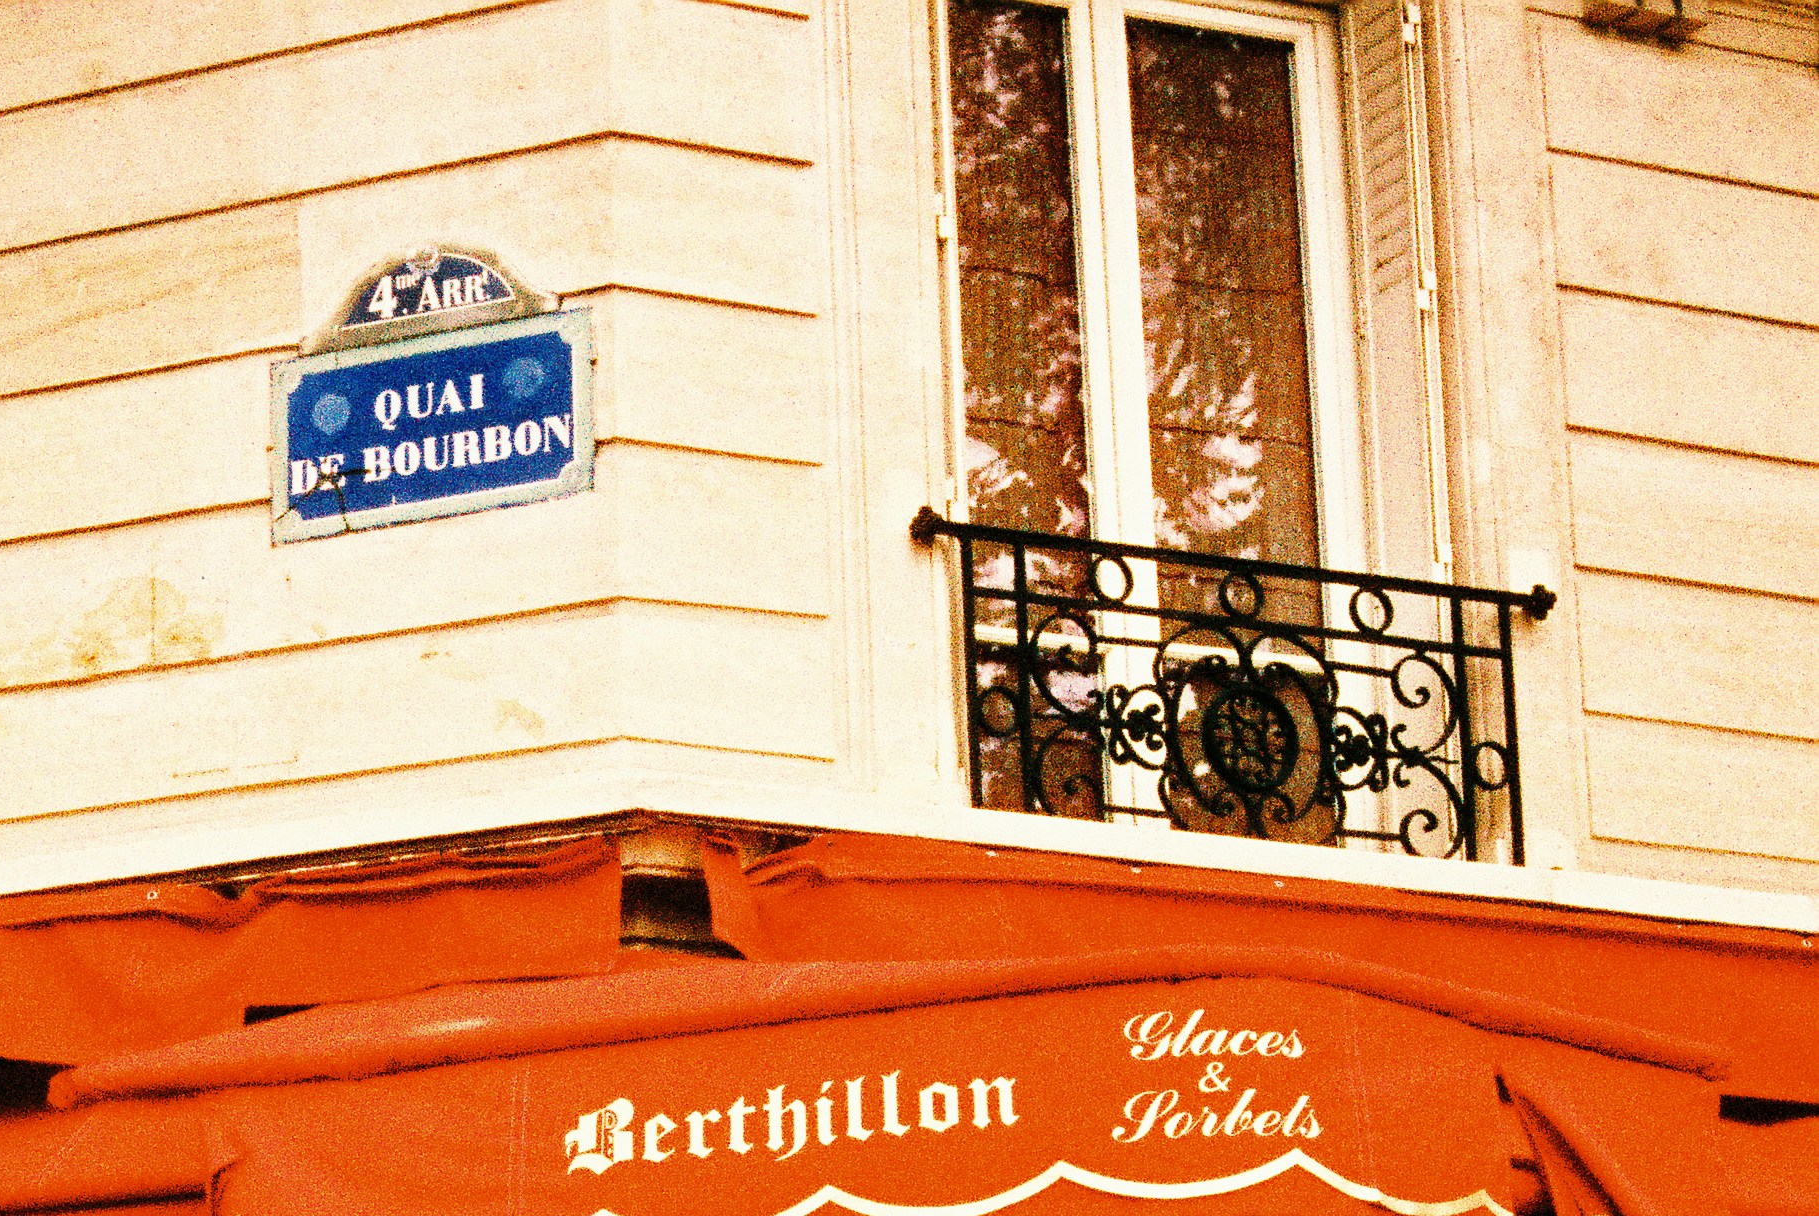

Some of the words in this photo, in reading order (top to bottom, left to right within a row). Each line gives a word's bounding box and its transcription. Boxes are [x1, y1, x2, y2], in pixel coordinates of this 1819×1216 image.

[374, 373, 484, 430] QUAI
[289, 453, 345, 496] DE
[363, 414, 572, 483] BOURBON
[1123, 1008, 1306, 1061] Glaces
[1198, 1061, 1231, 1093] &
[564, 1070, 1021, 1176] Berthillon
